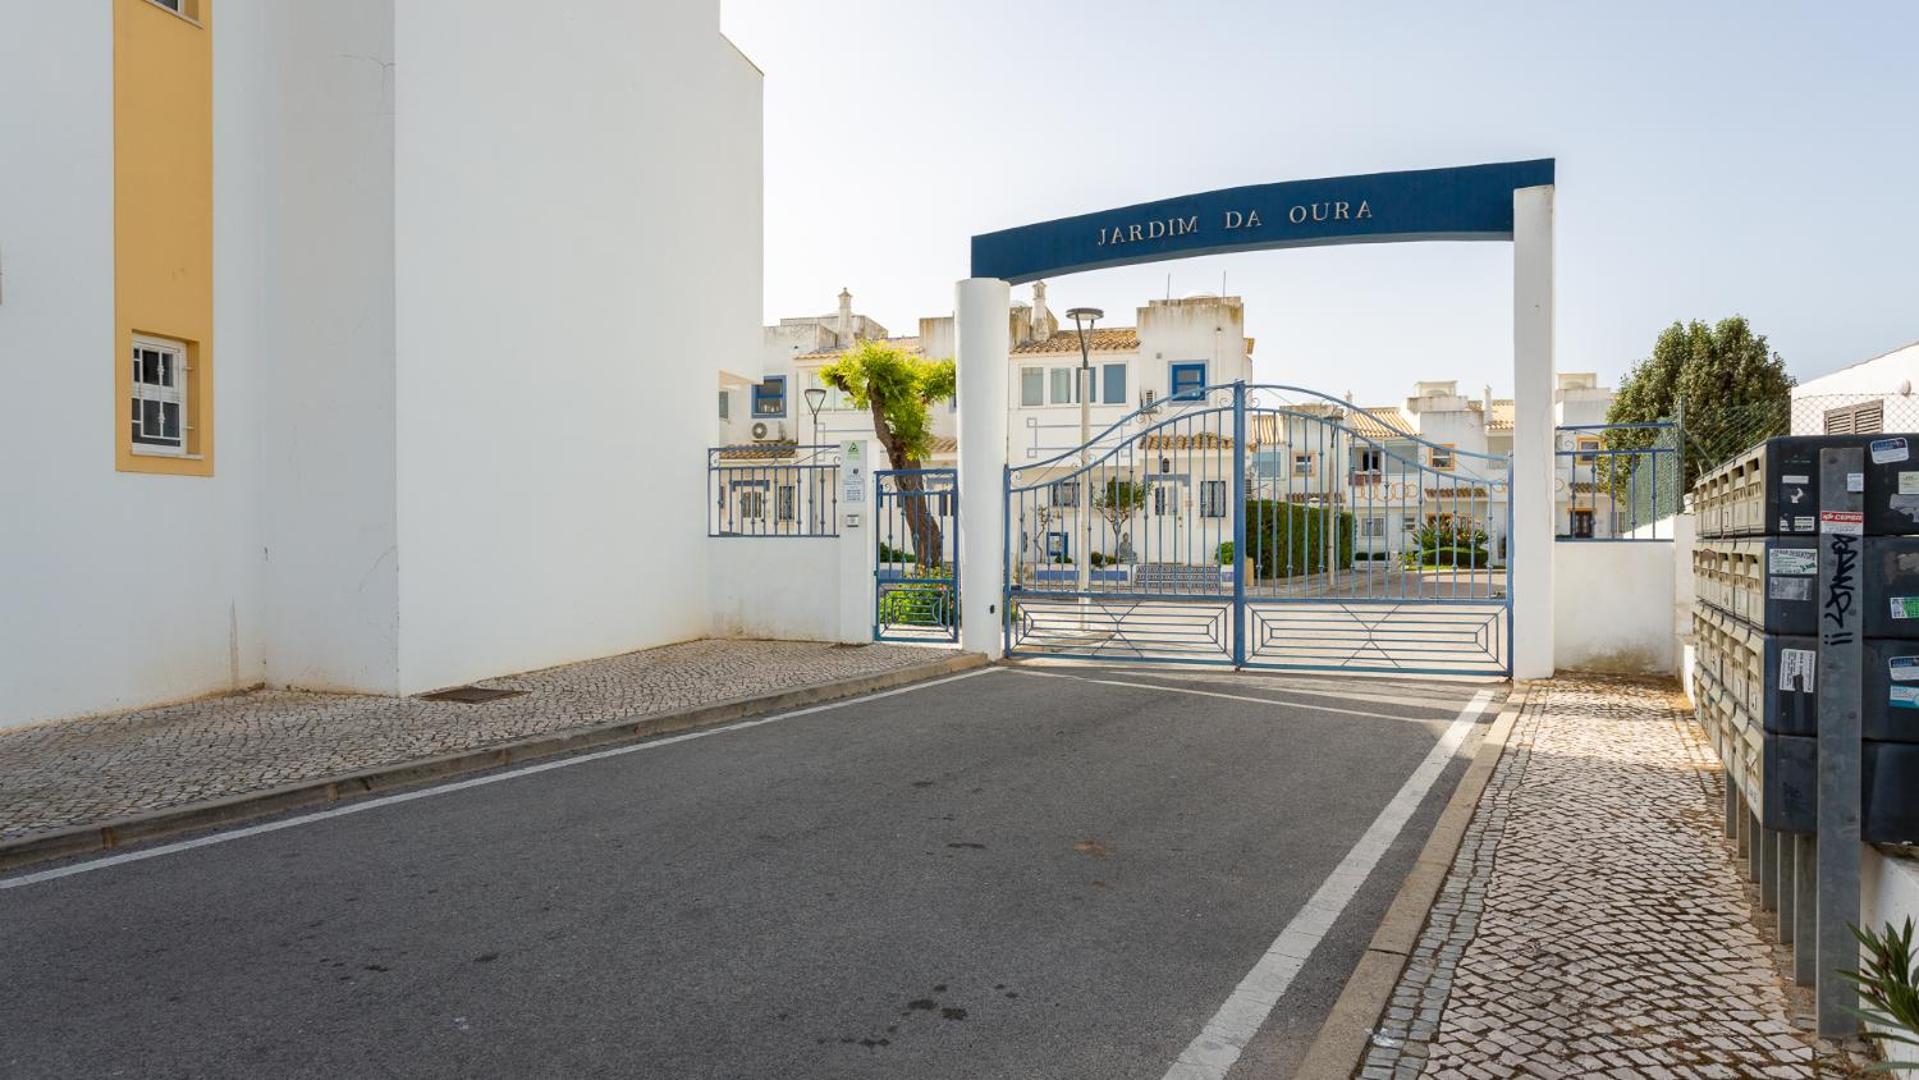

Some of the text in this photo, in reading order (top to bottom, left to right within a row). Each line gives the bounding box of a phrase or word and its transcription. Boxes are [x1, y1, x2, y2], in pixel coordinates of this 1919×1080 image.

[1098, 200, 1373, 247] JARDIM DA OURA
